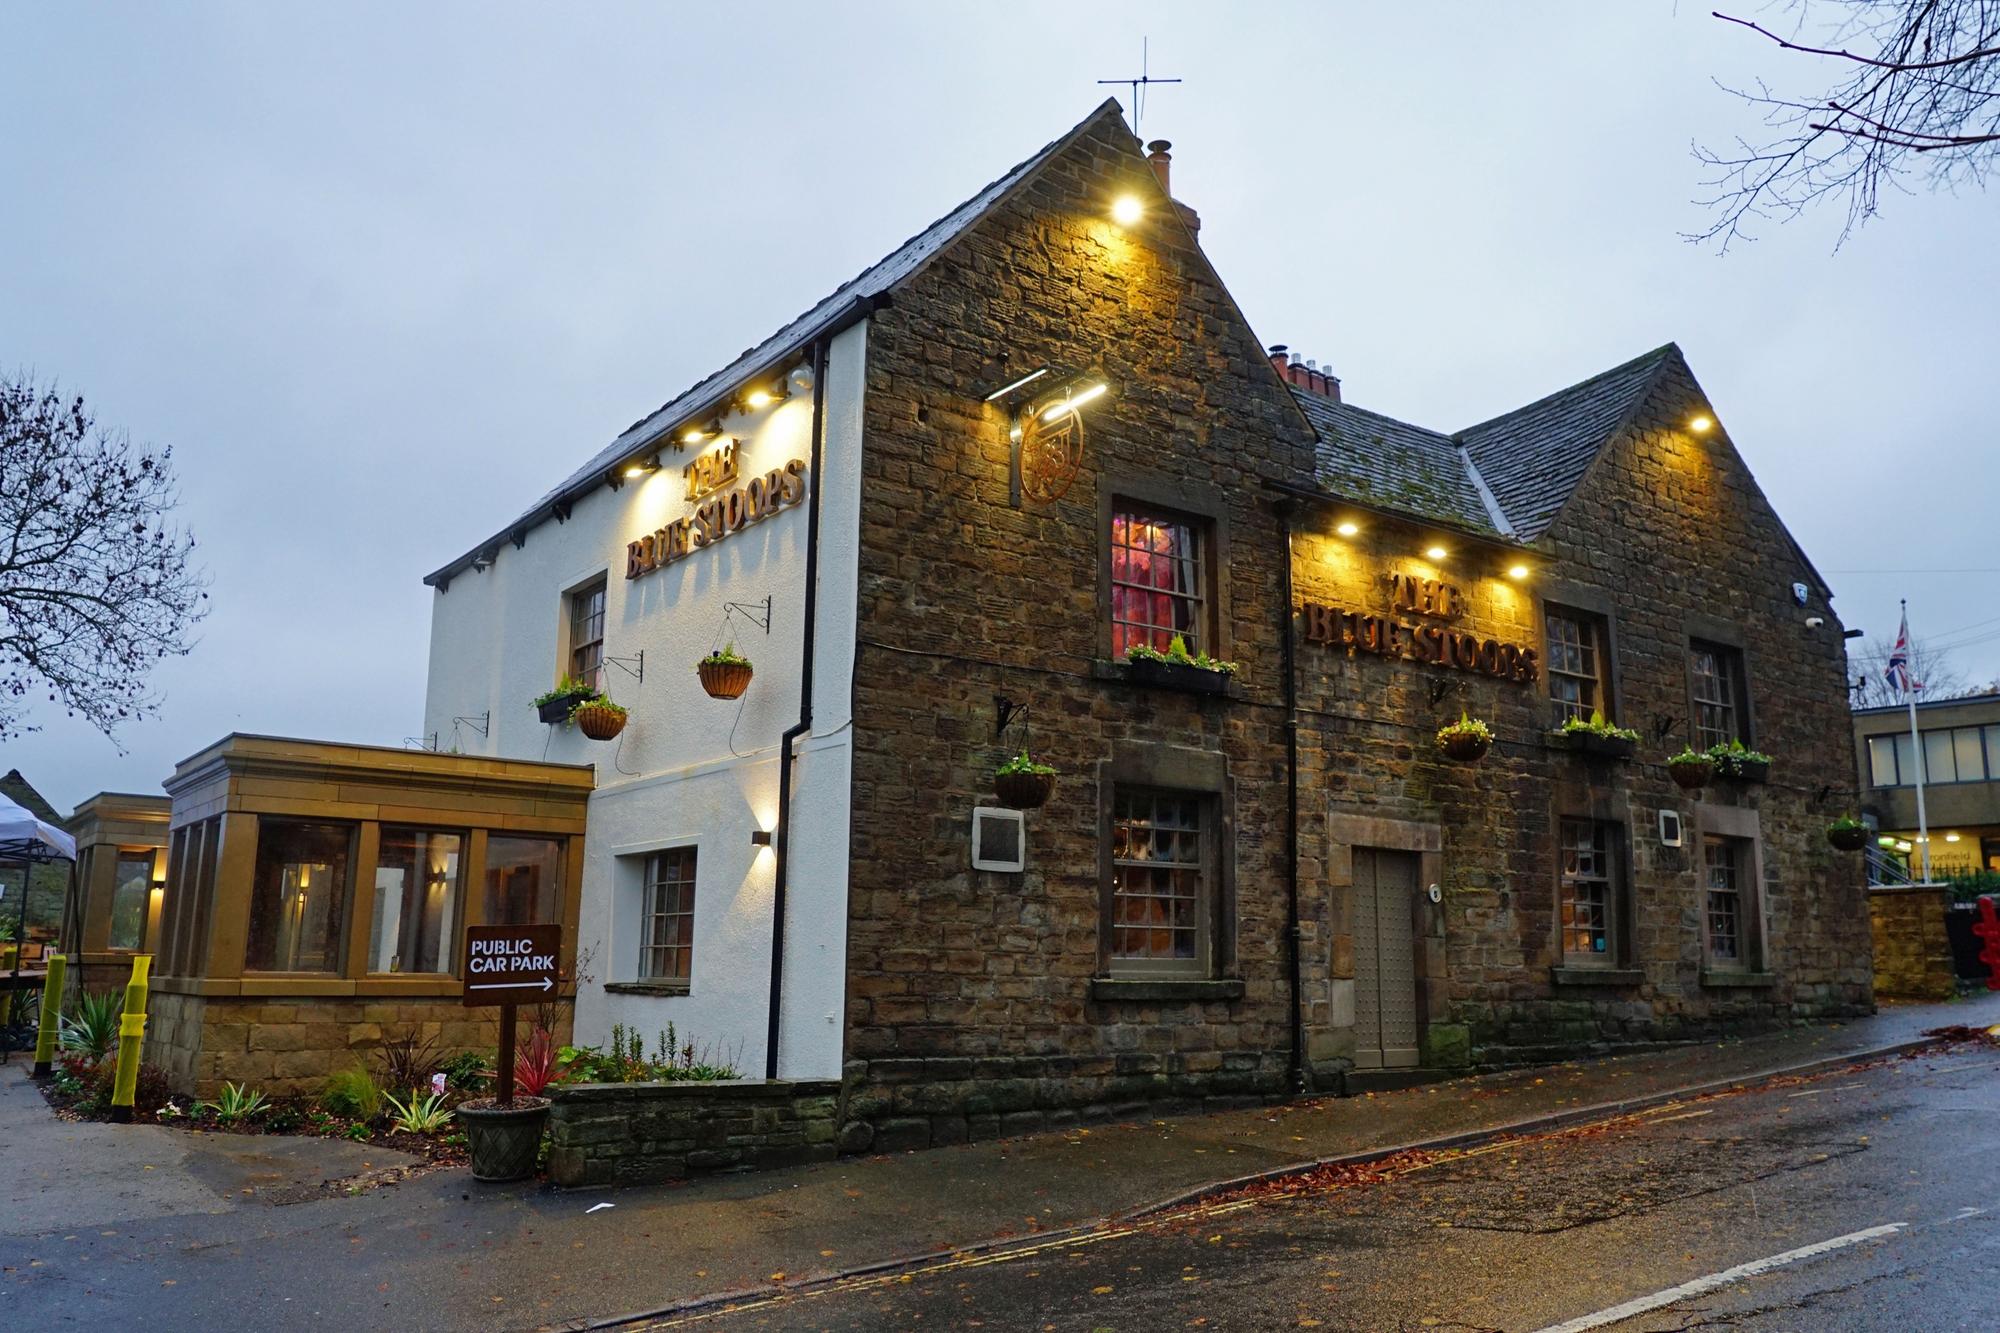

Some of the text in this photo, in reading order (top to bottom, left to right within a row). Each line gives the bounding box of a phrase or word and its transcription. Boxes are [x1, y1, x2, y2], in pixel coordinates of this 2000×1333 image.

[683, 438, 740, 501] THE
[625, 459, 805, 579] BLUE STOOPS
[1391, 572, 1465, 619] THE
[1303, 603, 1540, 681] BLUE STOOPS
[470, 955, 555, 973] CAR PARK
[471, 939, 533, 956] PUBLIC
